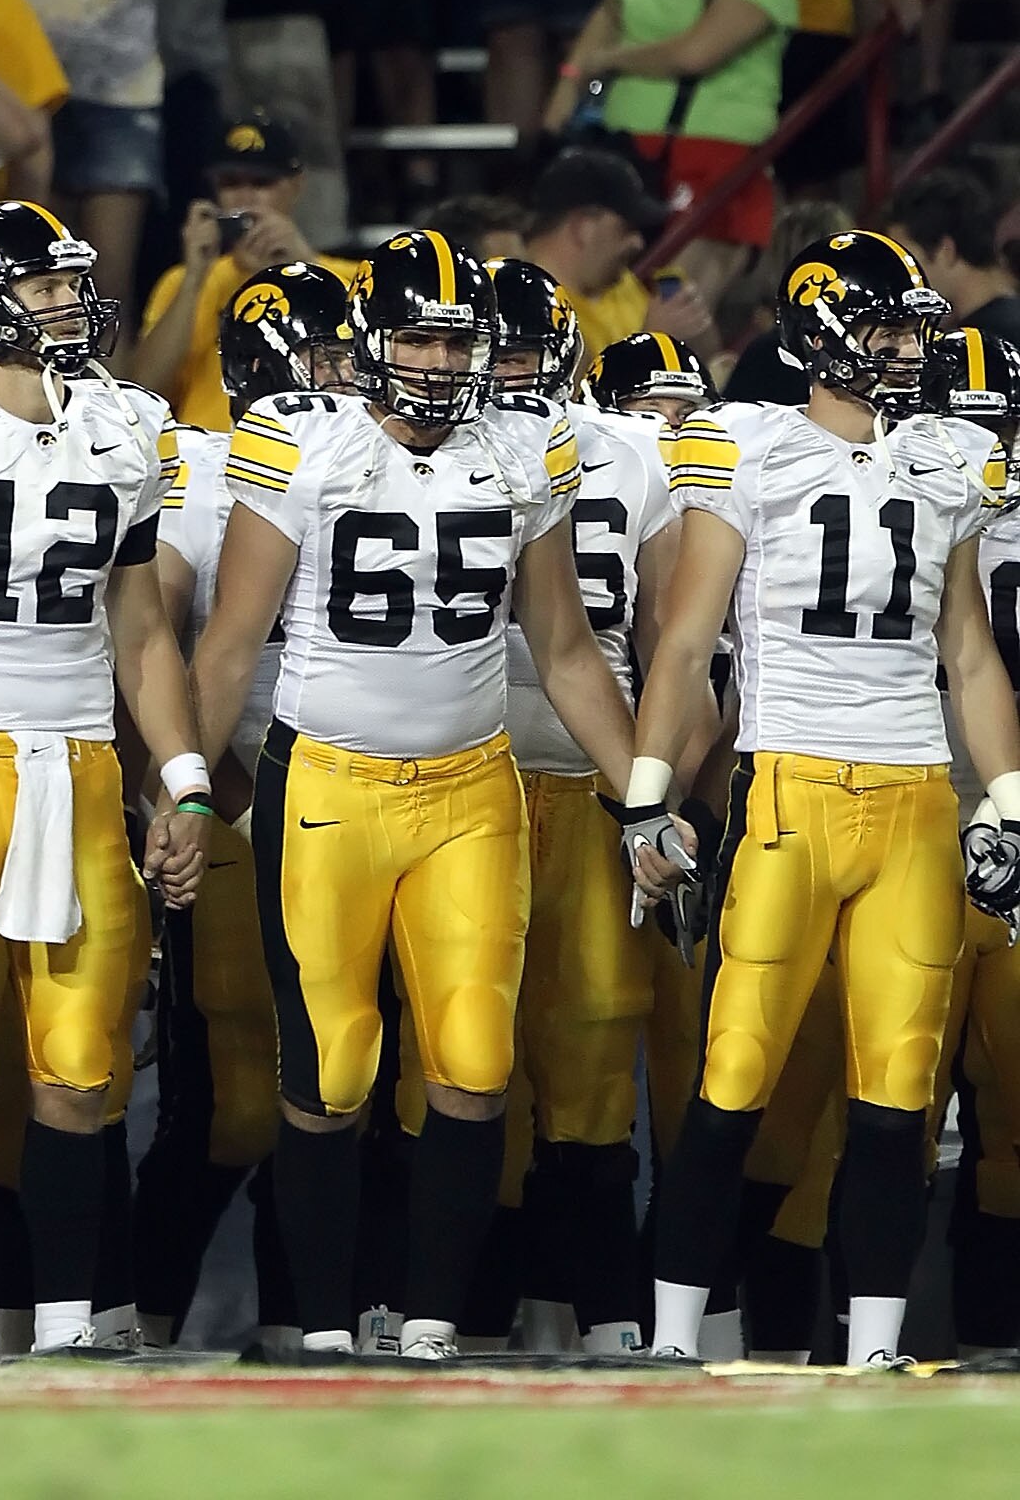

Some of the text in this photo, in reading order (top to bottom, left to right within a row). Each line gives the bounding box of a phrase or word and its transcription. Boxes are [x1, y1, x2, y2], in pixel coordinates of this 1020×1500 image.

[965, 393, 991, 402] IOWA
[327, 508, 514, 648] 65
[800, 493, 917, 641] 11
